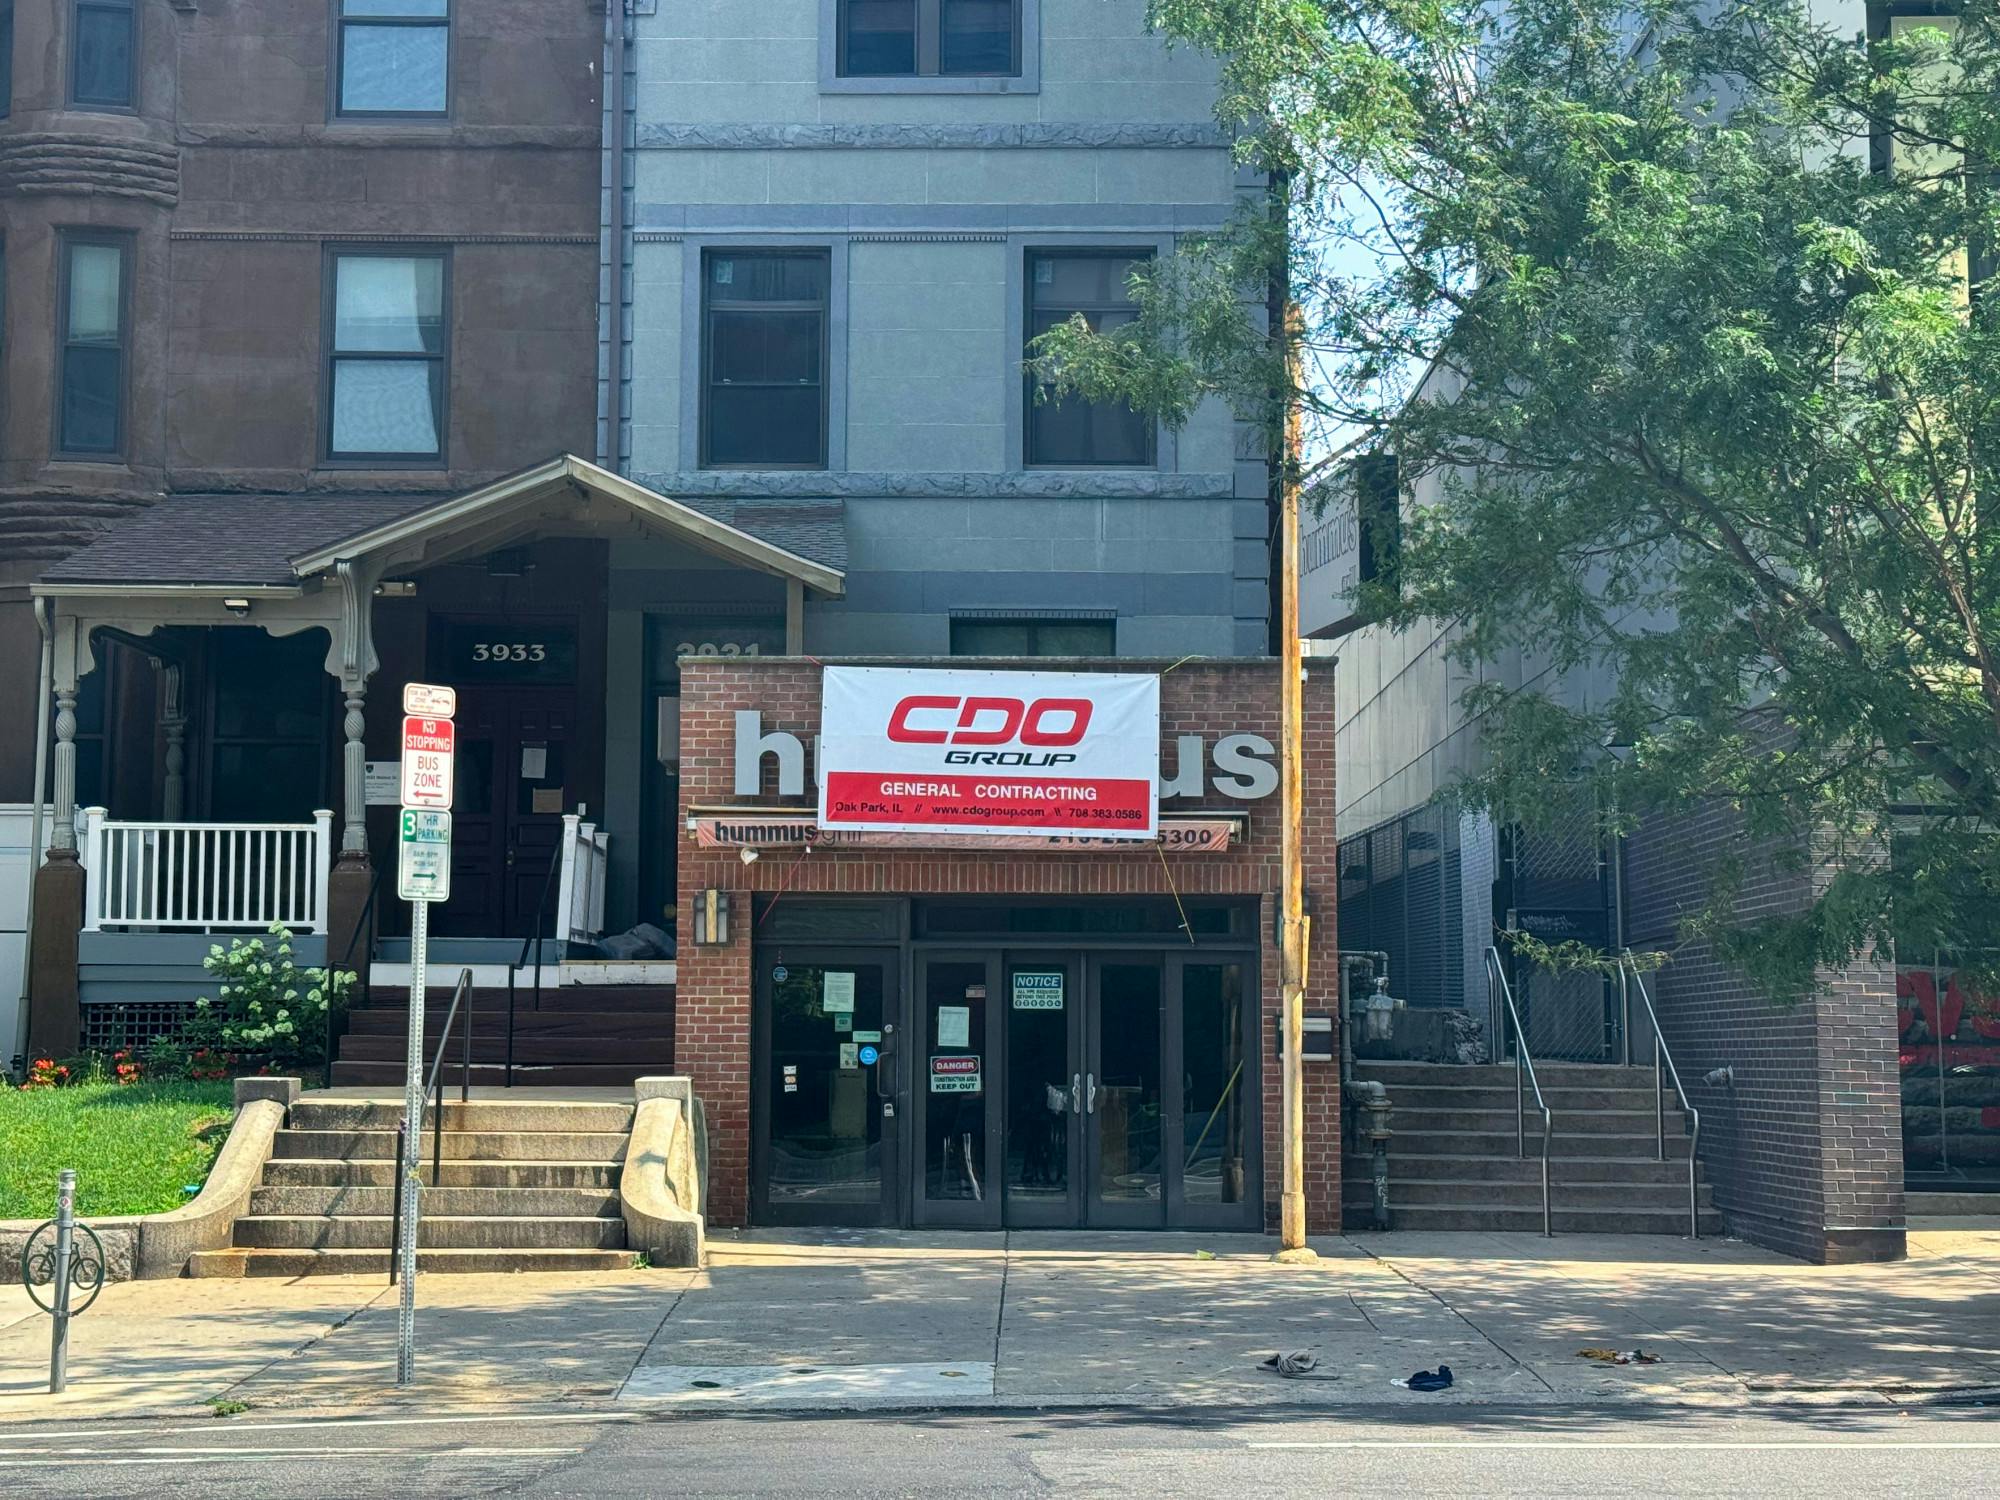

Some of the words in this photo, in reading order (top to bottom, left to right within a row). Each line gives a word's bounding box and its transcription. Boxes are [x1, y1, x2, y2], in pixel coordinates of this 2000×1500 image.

[472, 644, 546, 661] 3933
[422, 721, 437, 734] NO
[887, 695, 1093, 746] CDO
[407, 735, 451, 751] STOPPING
[417, 756, 439, 771] BUS
[944, 751, 1077, 766] GROUP
[414, 773, 442, 788] ZONE
[880, 781, 961, 797] GENERAL
[975, 785, 1097, 800] CONTRACTING
[835, 802, 857, 812] Oak
[860, 802, 889, 814] Park,
[892, 803, 903, 812] IL
[932, 806, 1045, 818] www.cdogroup.com
[404, 813, 416, 836] 3
[715, 822, 817, 841] hummus
[417, 828, 448, 841] PARKING
[1017, 976, 1060, 987] NOTICE
[936, 1062, 974, 1070] DANGER
